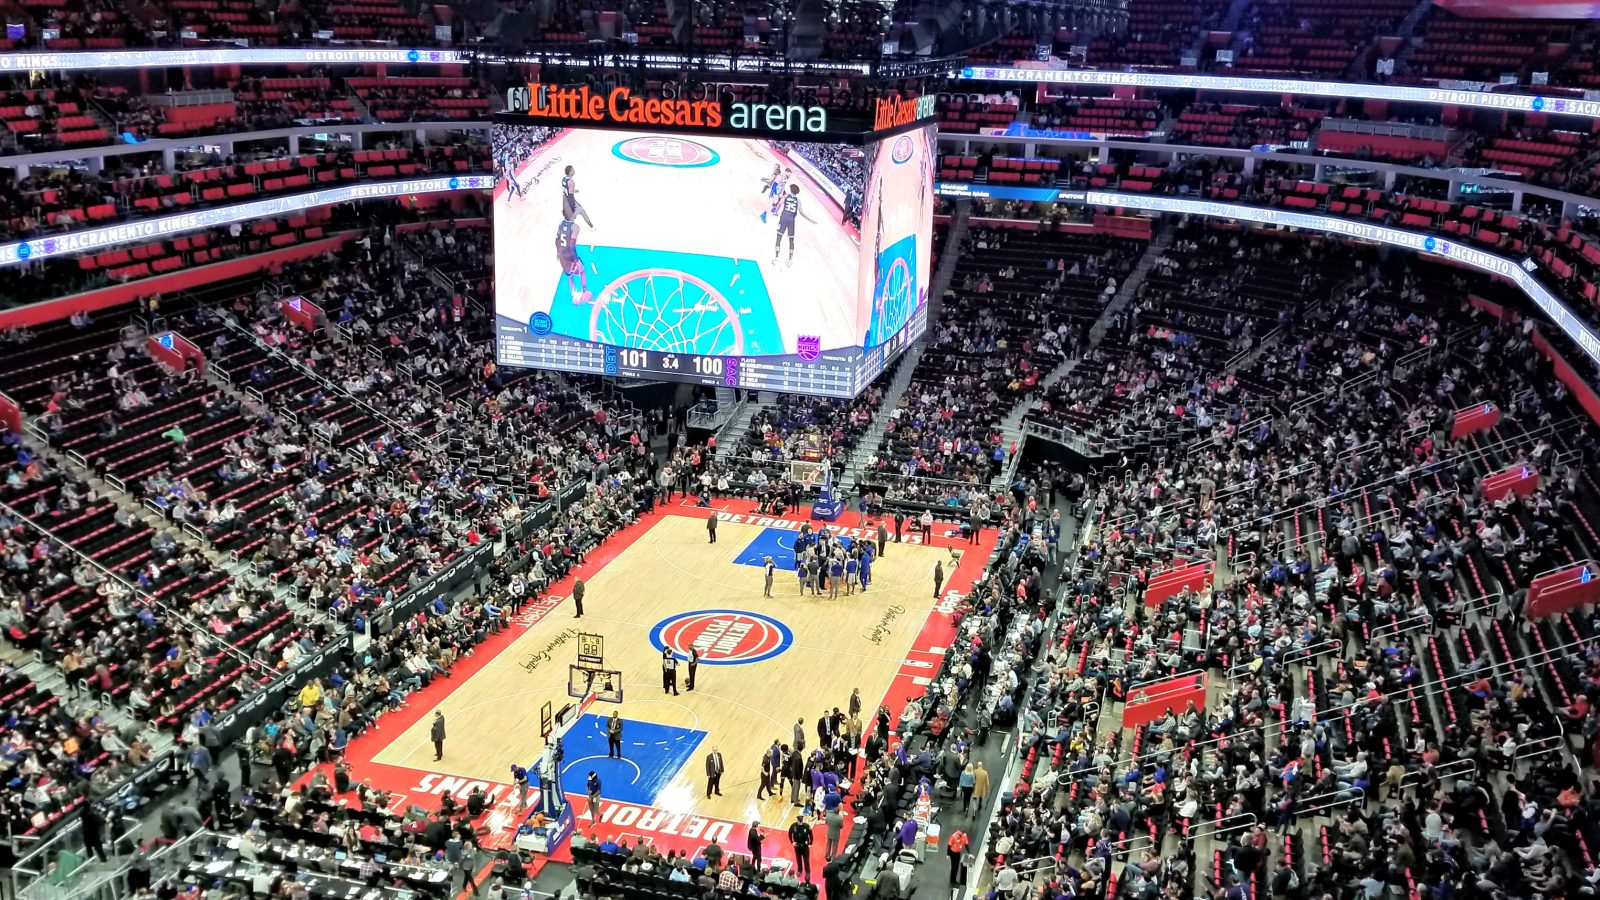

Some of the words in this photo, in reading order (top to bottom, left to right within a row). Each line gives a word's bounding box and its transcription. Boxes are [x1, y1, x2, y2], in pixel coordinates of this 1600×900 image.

[16, 55, 58, 68] KINGS
[305, 51, 355, 61] DETROIT
[358, 51, 406, 61] PISTONS
[998, 69, 1091, 81] SACRAMENTO
[1097, 74, 1138, 84] KINGS
[527, 82, 604, 121] Little
[608, 86, 722, 127] Caesars
[729, 103, 827, 132] arena
[1429, 90, 1476, 102] DETROIT
[1481, 95, 1531, 108] PISTONS
[873, 97, 893, 131] Little
[893, 94, 917, 127] Caesars
[916, 94, 935, 120] arena
[350, 183, 397, 198] DETROIT
[402, 179, 448, 192] PISTONS
[58, 222, 153, 250] SACRAMENTO
[158, 214, 197, 233] KINGS
[1327, 219, 1372, 237] DETROIT
[1376, 229, 1423, 247] PISTONS
[1450, 247, 1508, 274] SACRAMENTO
[605, 346, 617, 374] DET
[619, 349, 648, 368] 101
[662, 357, 679, 370] 3.4
[693, 356, 723, 375] 100
[726, 357, 737, 386] SAC
[716, 511, 811, 532] DETROIT
[515, 595, 564, 628] DETROIT
[935, 590, 966, 614] Jeep
[692, 618, 732, 653] PISTONS
[711, 622, 755, 656] DETROIT
